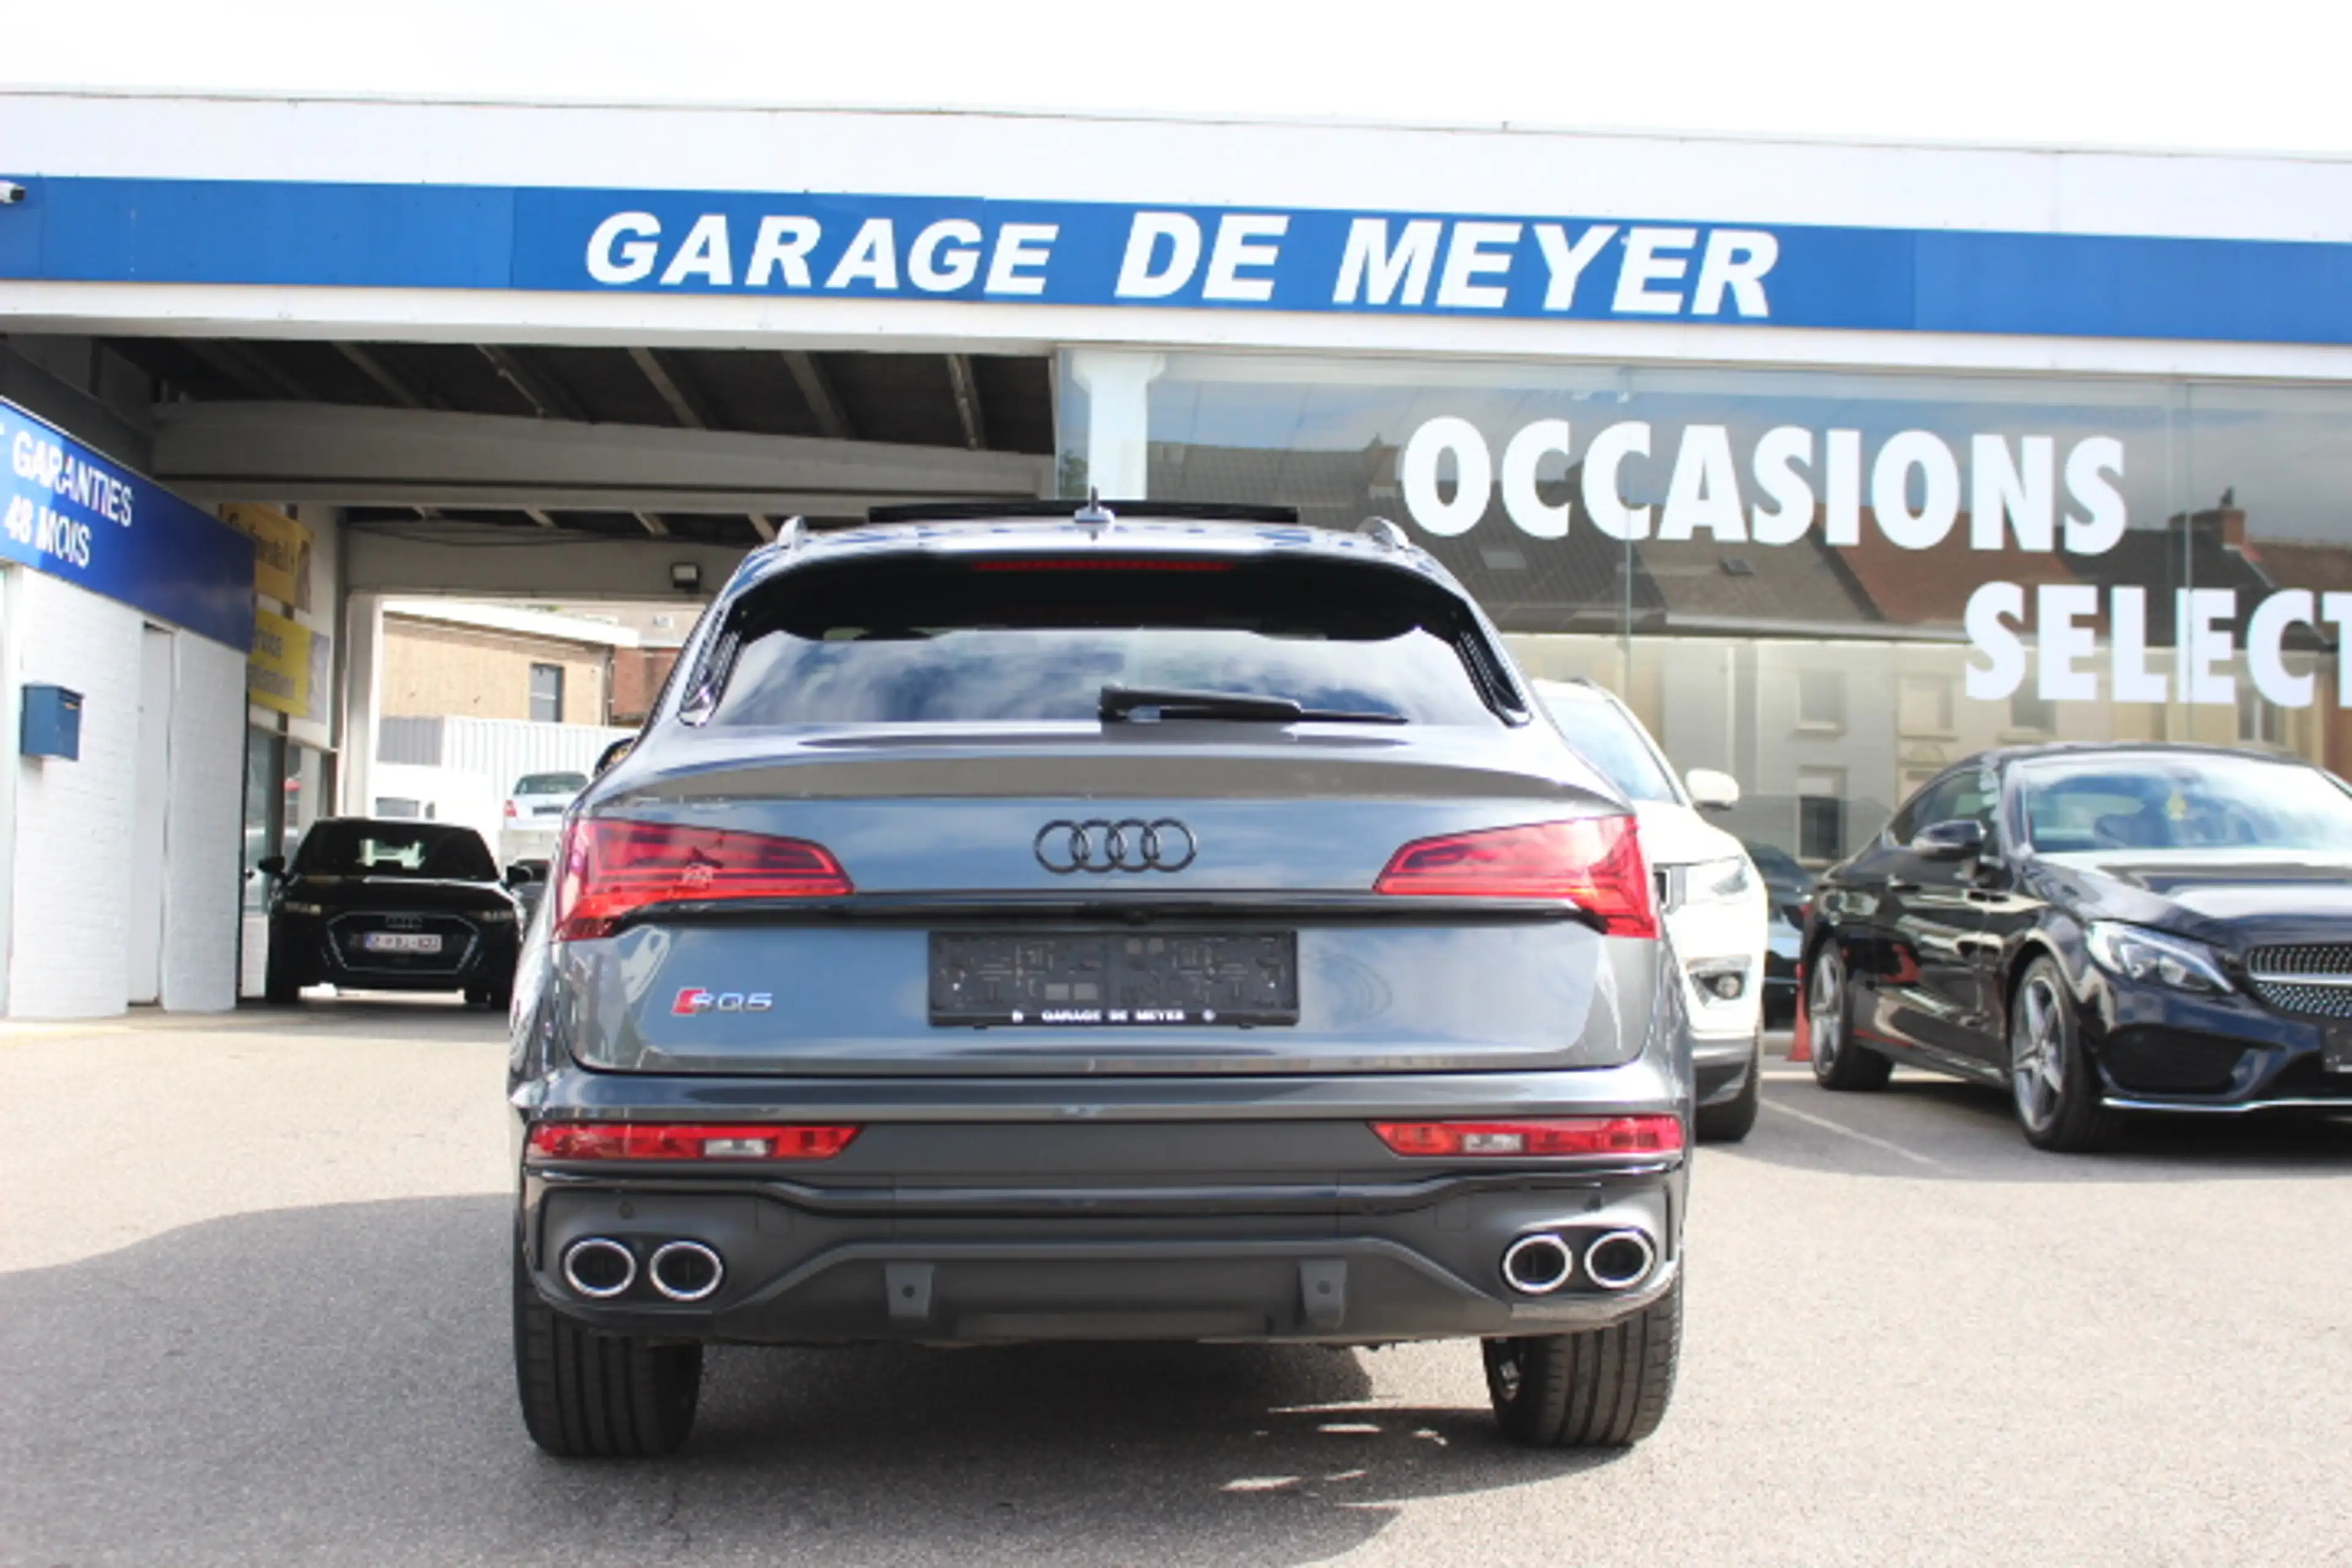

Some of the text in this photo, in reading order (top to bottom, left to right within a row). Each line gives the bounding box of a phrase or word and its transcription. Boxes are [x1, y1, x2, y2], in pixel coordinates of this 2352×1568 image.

[587, 211, 1779, 316] GARAGE DE MEYER
[12, 431, 133, 527] GARANTIES
[1401, 415, 2127, 555] OCCASIONS
[4, 494, 92, 568] 48 MOIS
[1041, 1009, 1185, 1022] GARAGE DE MEYER
